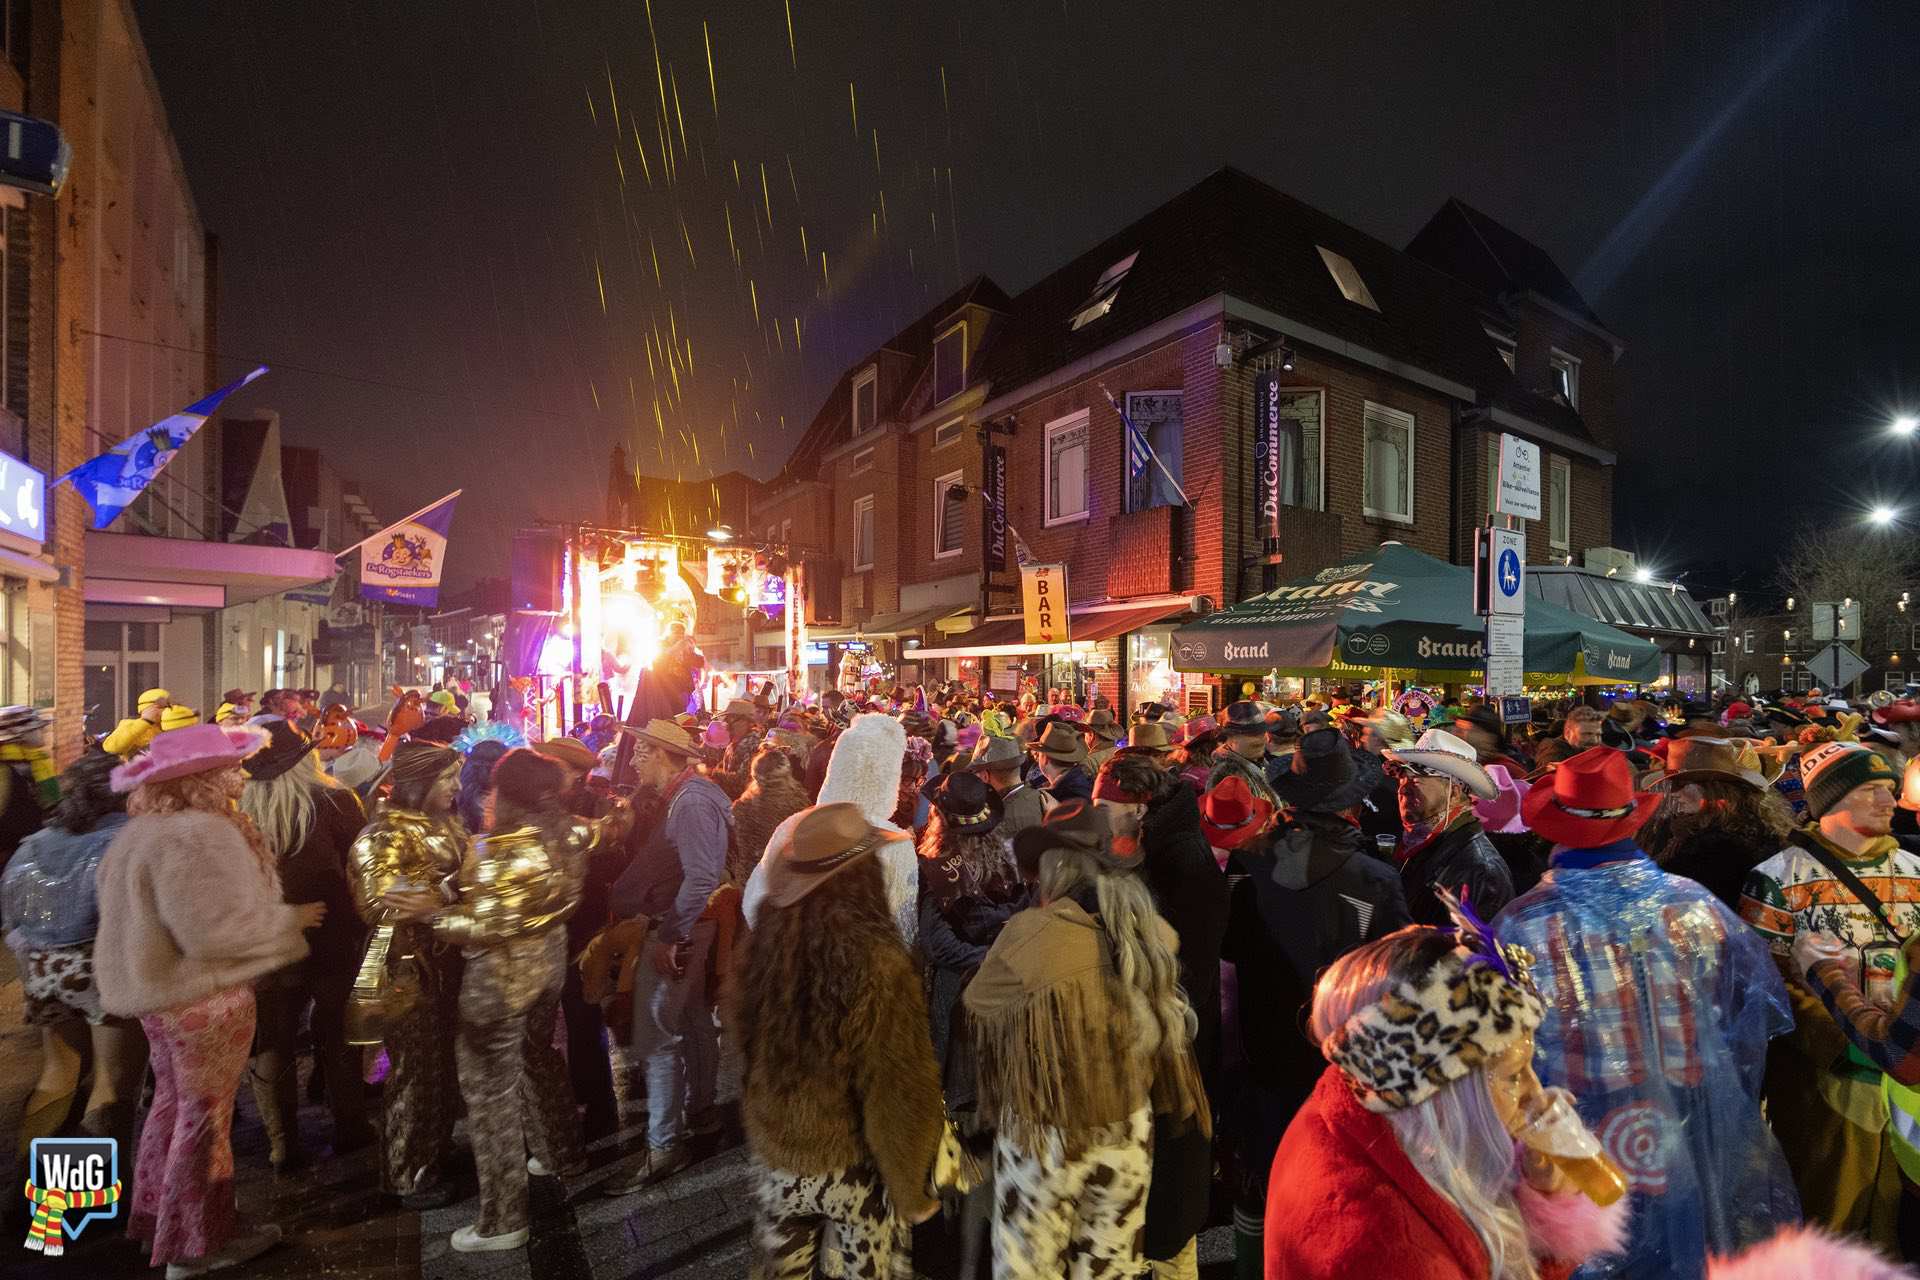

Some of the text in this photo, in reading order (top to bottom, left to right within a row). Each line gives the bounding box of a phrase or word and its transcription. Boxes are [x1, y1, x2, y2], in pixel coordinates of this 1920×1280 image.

[1502, 535, 1517, 546] ZONE
[1037, 580, 1051, 628] BAR
[1224, 641, 1269, 661] Brand
[1417, 636, 1483, 658] Brand
[1607, 650, 1632, 670] Brand
